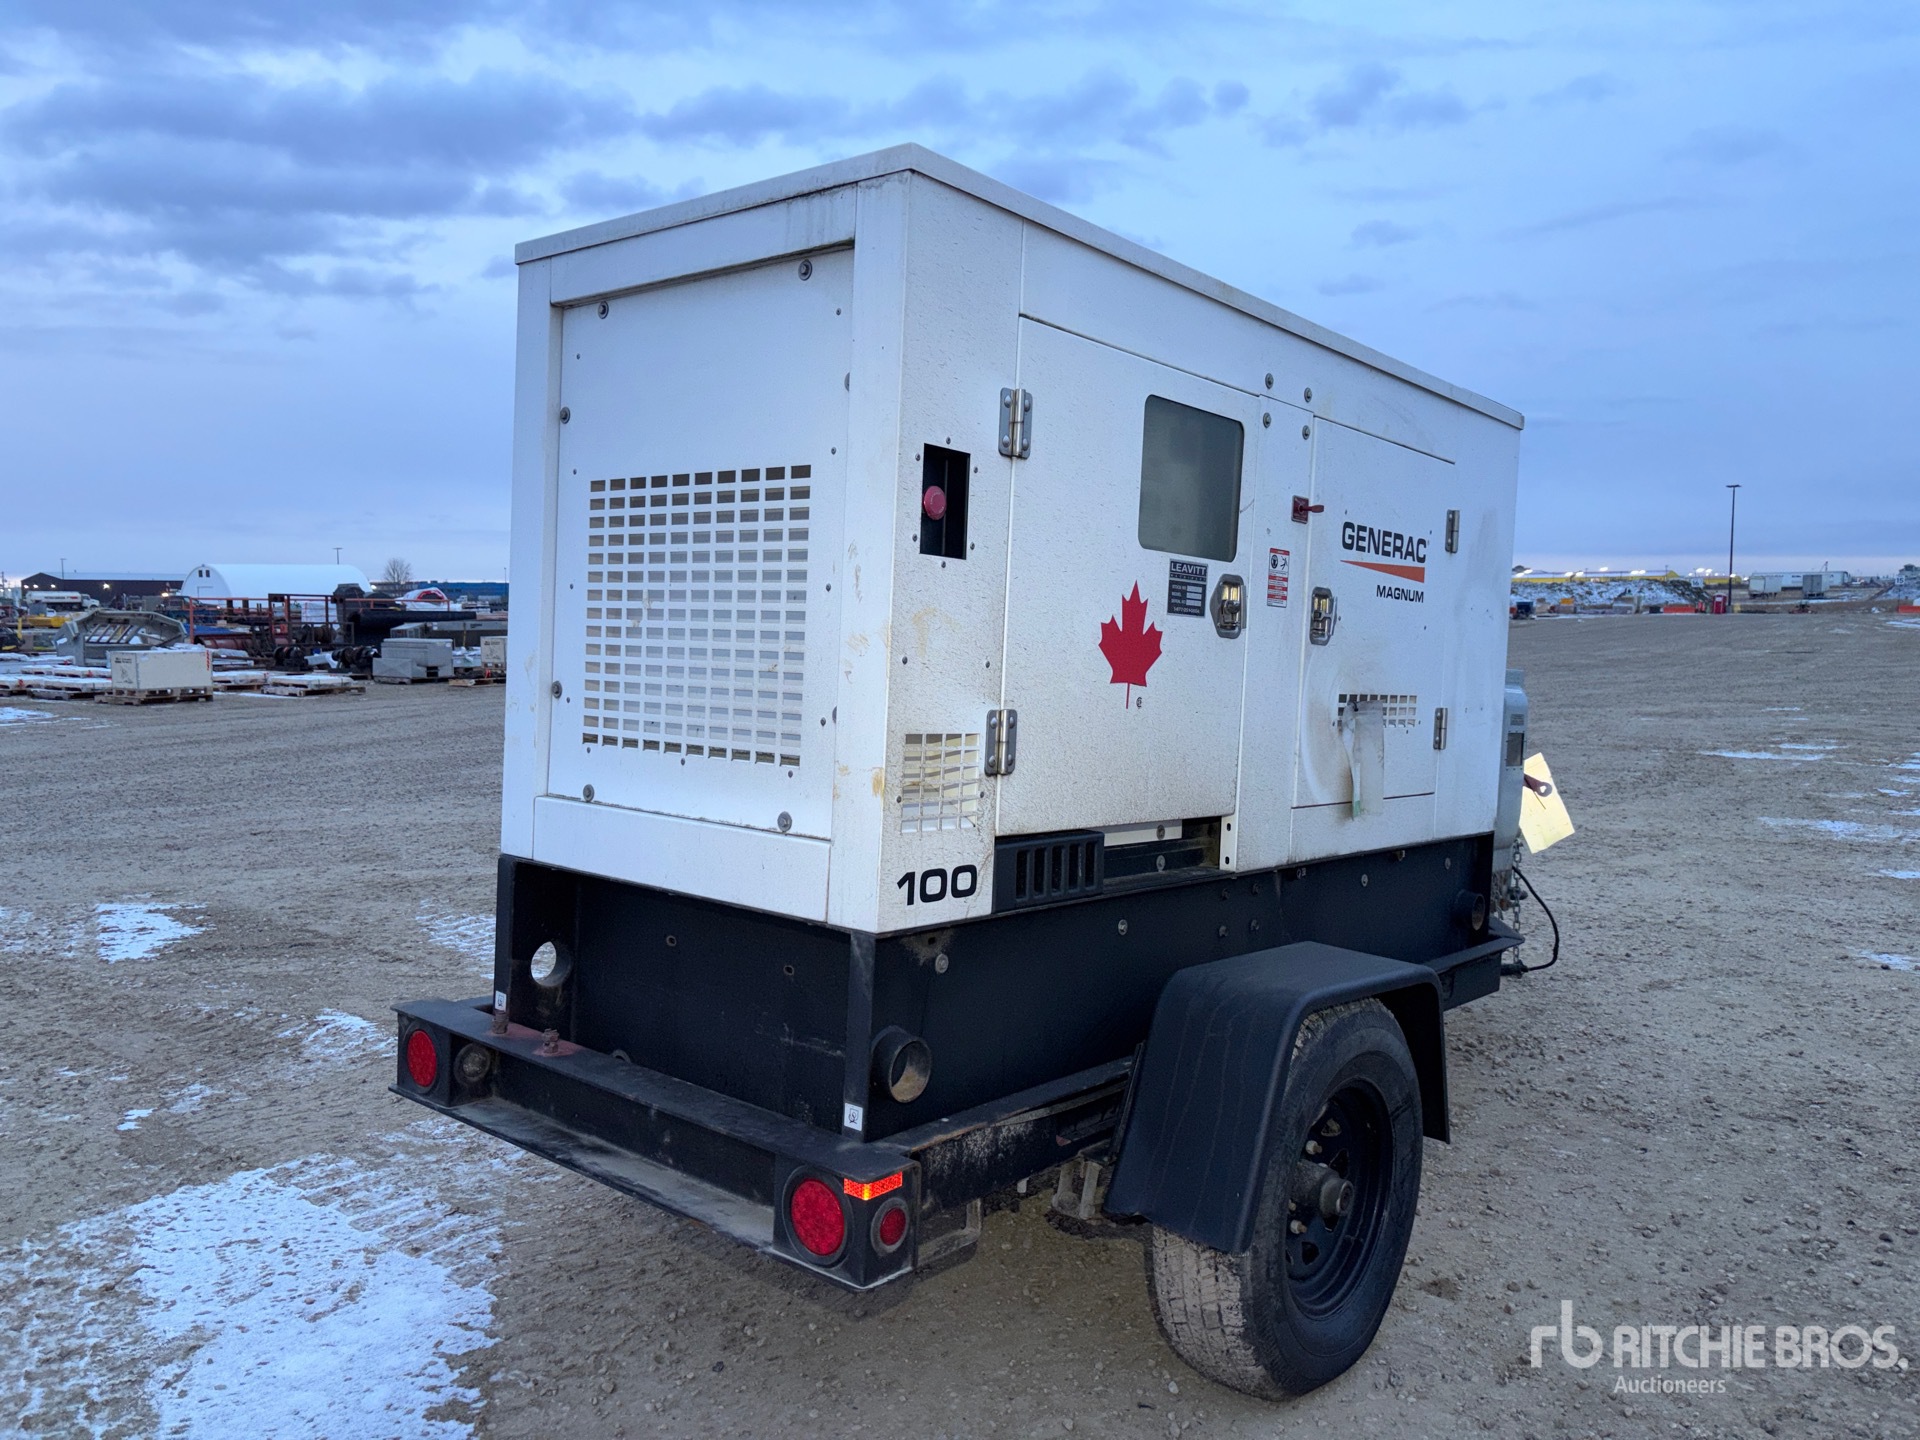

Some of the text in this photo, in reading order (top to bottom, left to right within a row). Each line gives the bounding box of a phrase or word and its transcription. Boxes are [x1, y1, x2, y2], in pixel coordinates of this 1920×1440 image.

[1342, 521, 1427, 564] GENERAC
[1171, 562, 1206, 575] LEAVITT
[1376, 585, 1425, 603] MAGNUM
[897, 864, 978, 906] 100
